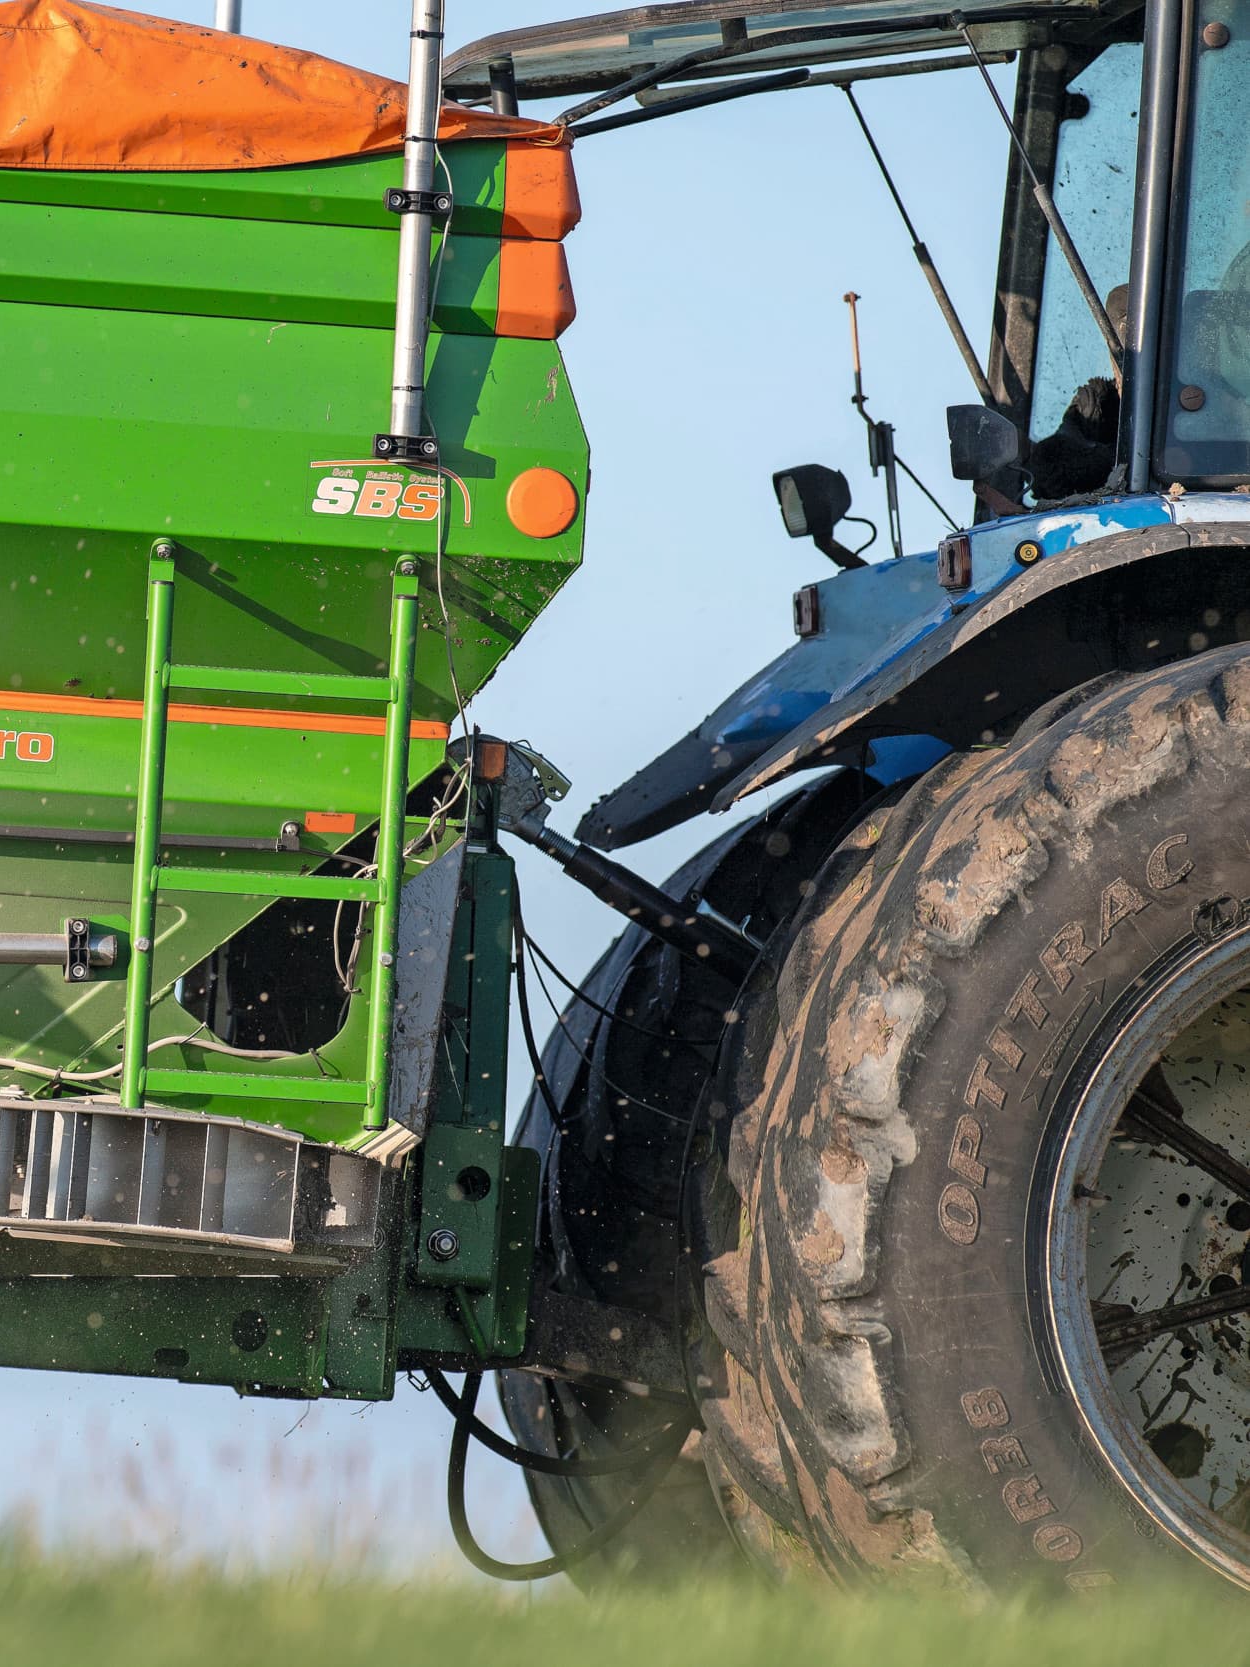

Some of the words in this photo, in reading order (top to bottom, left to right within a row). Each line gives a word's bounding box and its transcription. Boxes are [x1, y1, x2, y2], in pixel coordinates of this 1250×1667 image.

[332, 468, 353, 477] Soft
[312, 476, 444, 521] SBS
[938, 833, 1196, 1246] OPTITRAC
